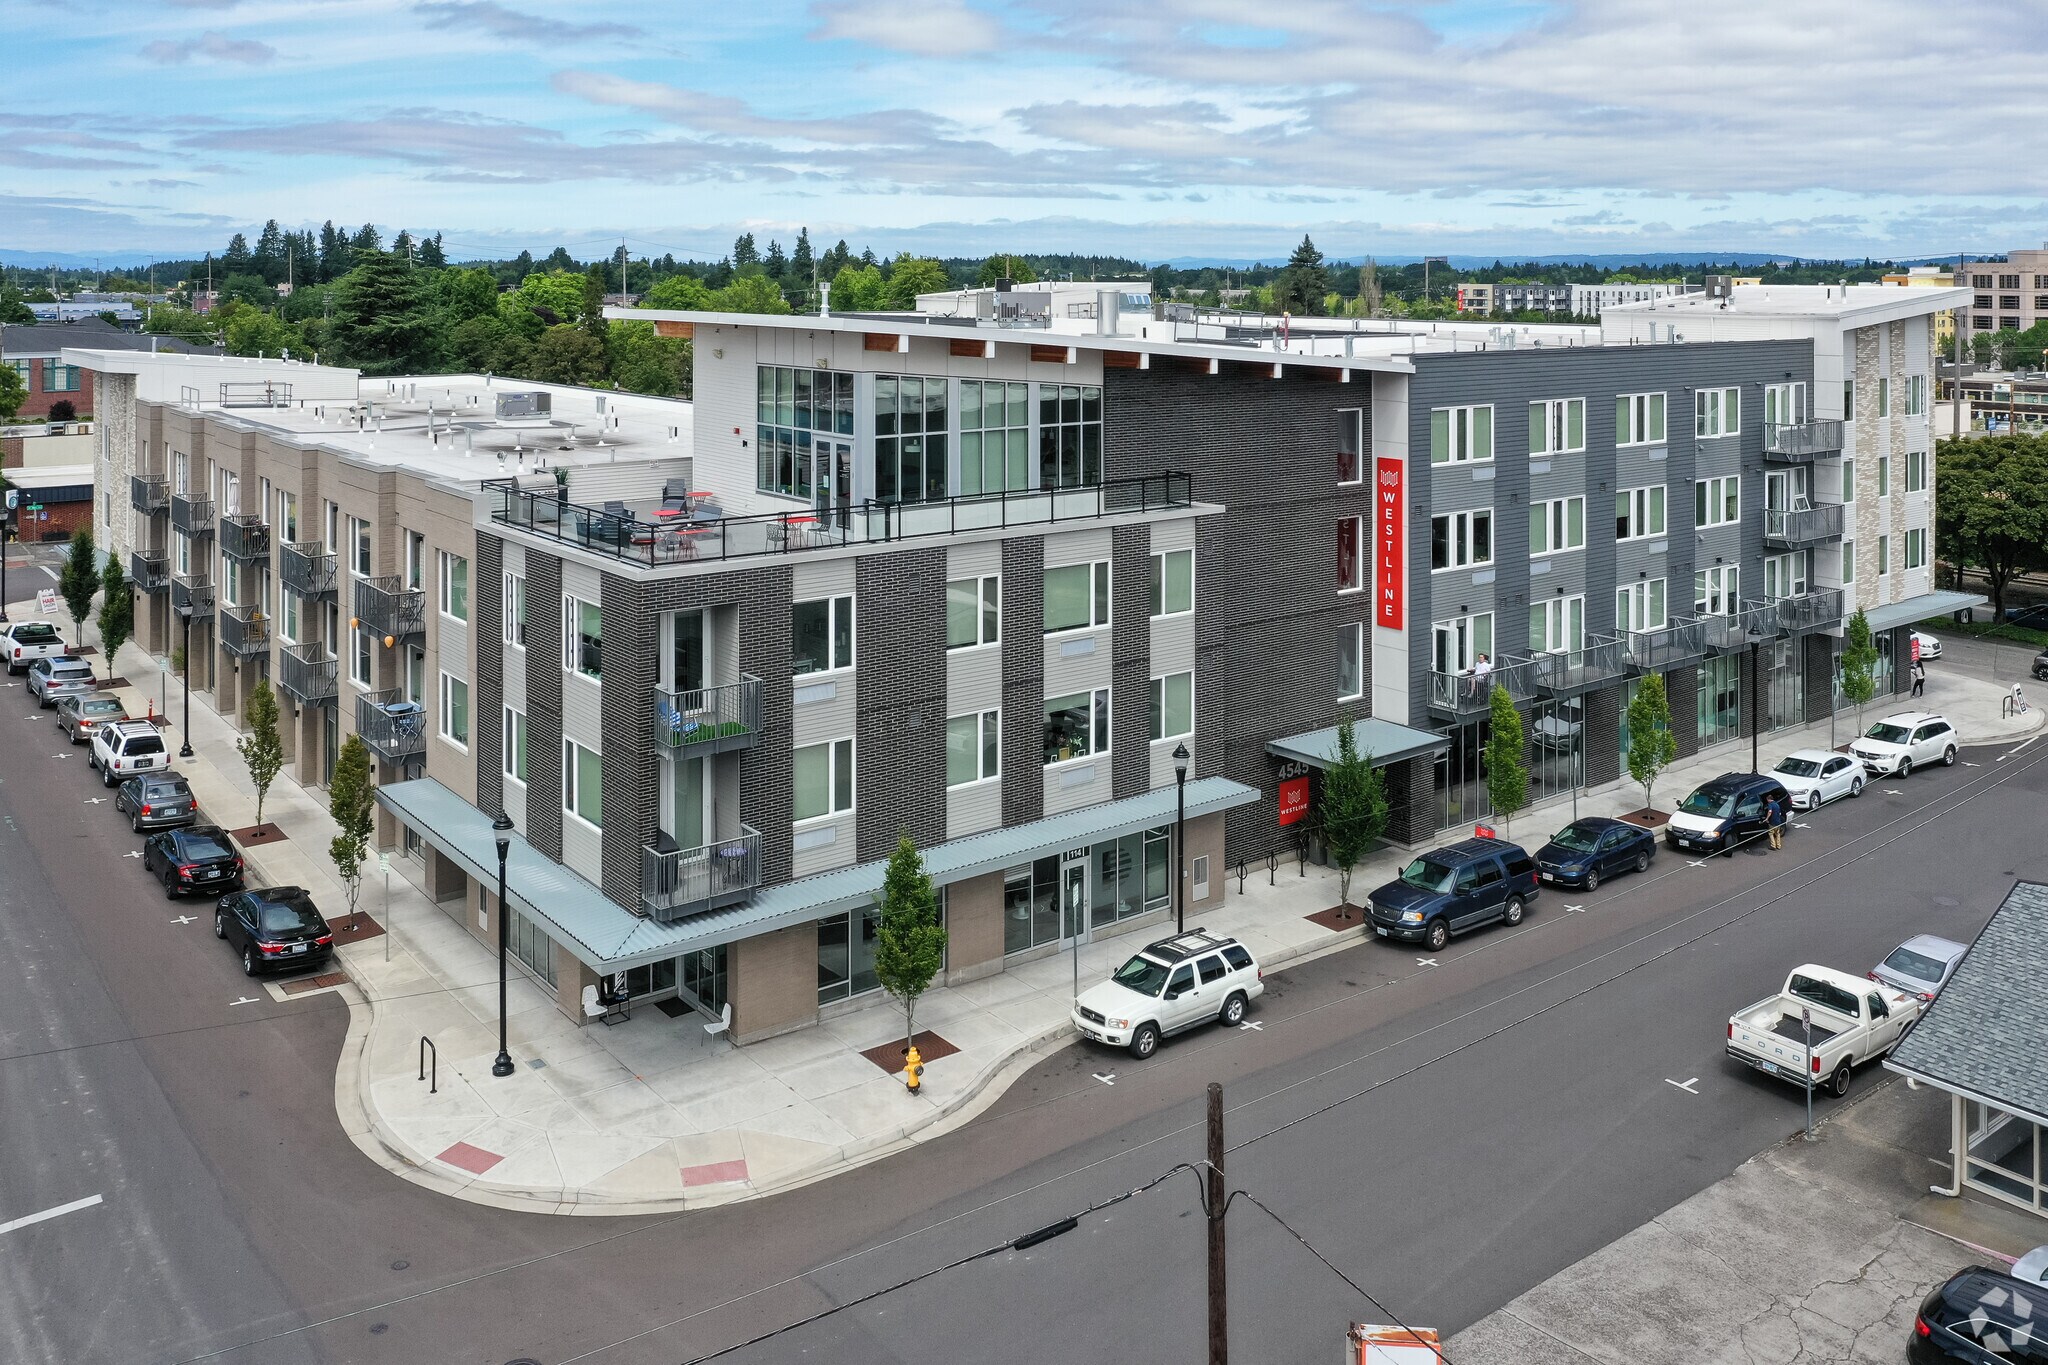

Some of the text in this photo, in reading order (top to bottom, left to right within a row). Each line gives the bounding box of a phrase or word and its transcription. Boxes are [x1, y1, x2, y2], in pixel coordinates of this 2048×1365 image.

[1383, 491, 1395, 616] WESTLINE
[1278, 761, 1309, 779] 4545
[1280, 803, 1308, 815] WESTLINE
[1070, 848, 1082, 859] 114
[1742, 1034, 1800, 1062] FORD
